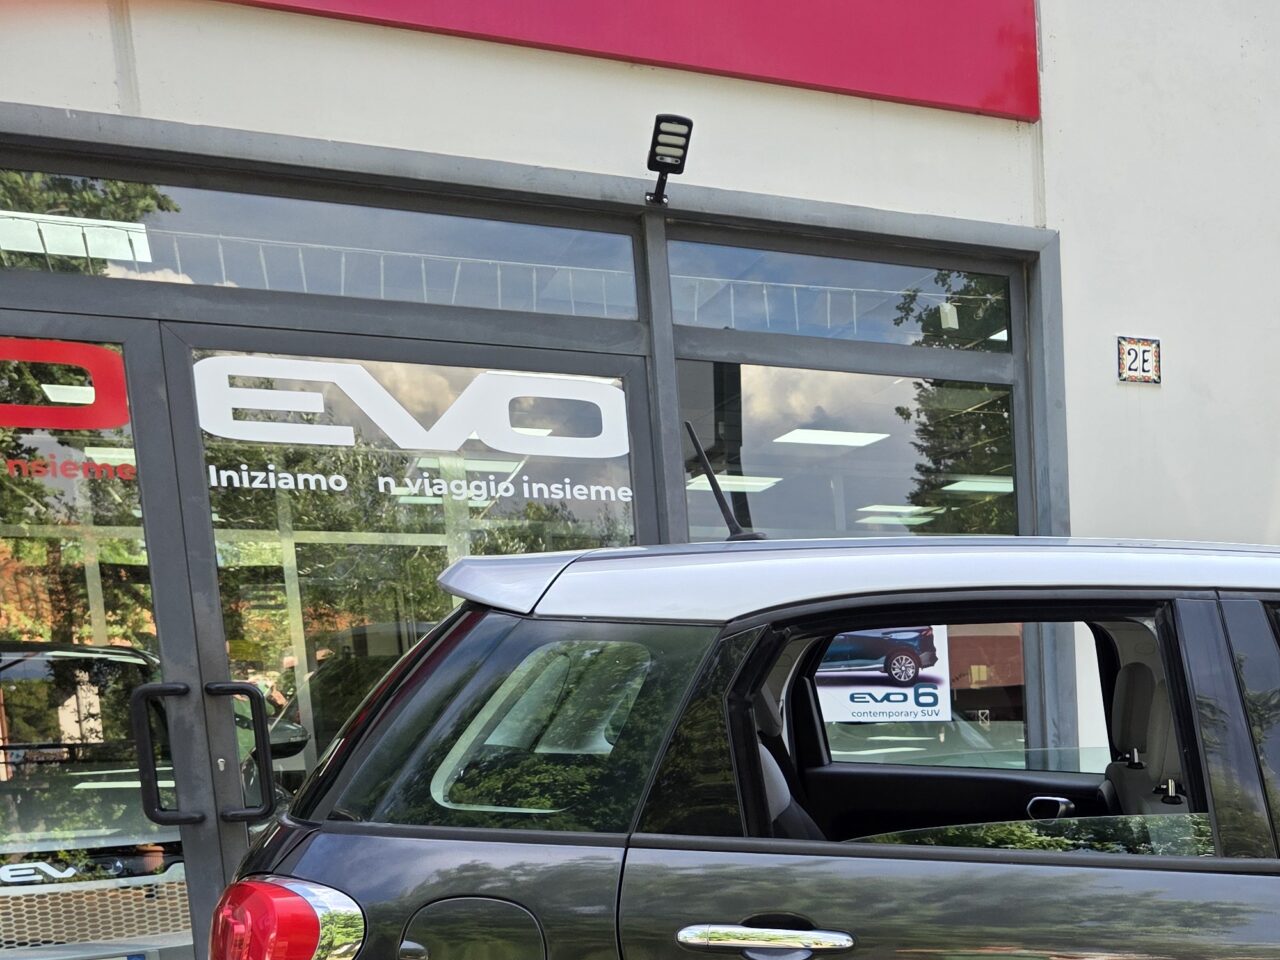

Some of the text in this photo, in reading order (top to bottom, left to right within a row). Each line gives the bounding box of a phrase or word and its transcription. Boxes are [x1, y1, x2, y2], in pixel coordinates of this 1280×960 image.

[1127, 347, 1151, 373] 2E
[192, 355, 630, 459] EVO
[208, 464, 349, 493] Iniziamo
[405, 470, 516, 502] viaggio
[522, 475, 634, 502] insieme
[849, 682, 939, 708] EVO 6
[851, 709, 940, 719] contemporary SUV
